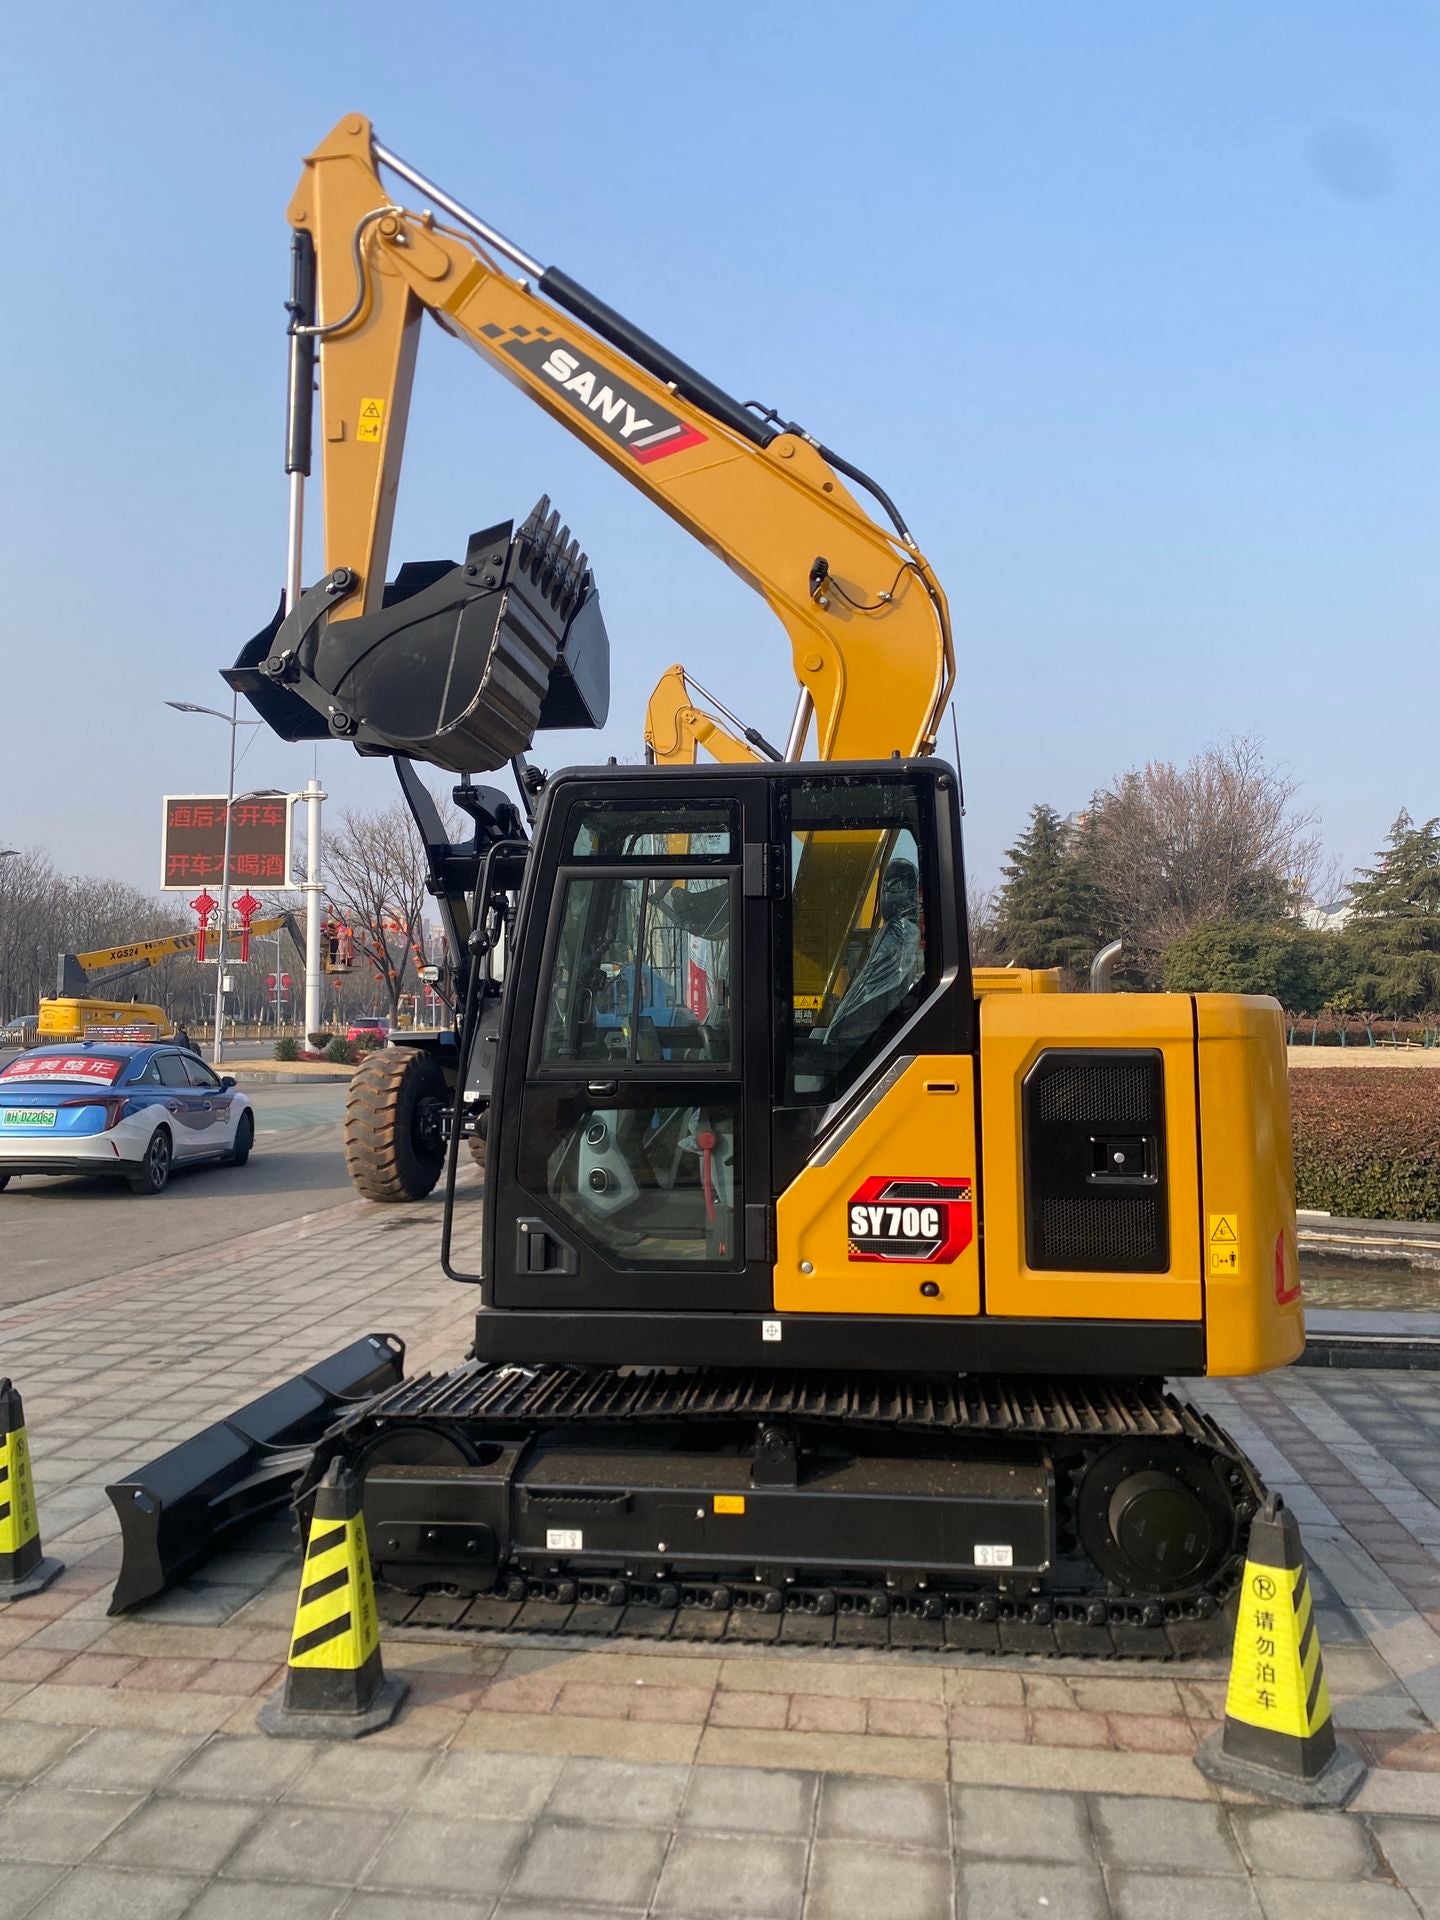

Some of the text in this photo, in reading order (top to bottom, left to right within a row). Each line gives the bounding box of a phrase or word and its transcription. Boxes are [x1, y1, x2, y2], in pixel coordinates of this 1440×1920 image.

[541, 349, 653, 438] SANY
[169, 804, 285, 827] 酒后不开车
[167, 853, 284, 876] 开车不喝酒
[110, 948, 139, 961] XGS24
[851, 1206, 939, 1237] SY70C
[1254, 1610, 1276, 1710] 请勿泊车
